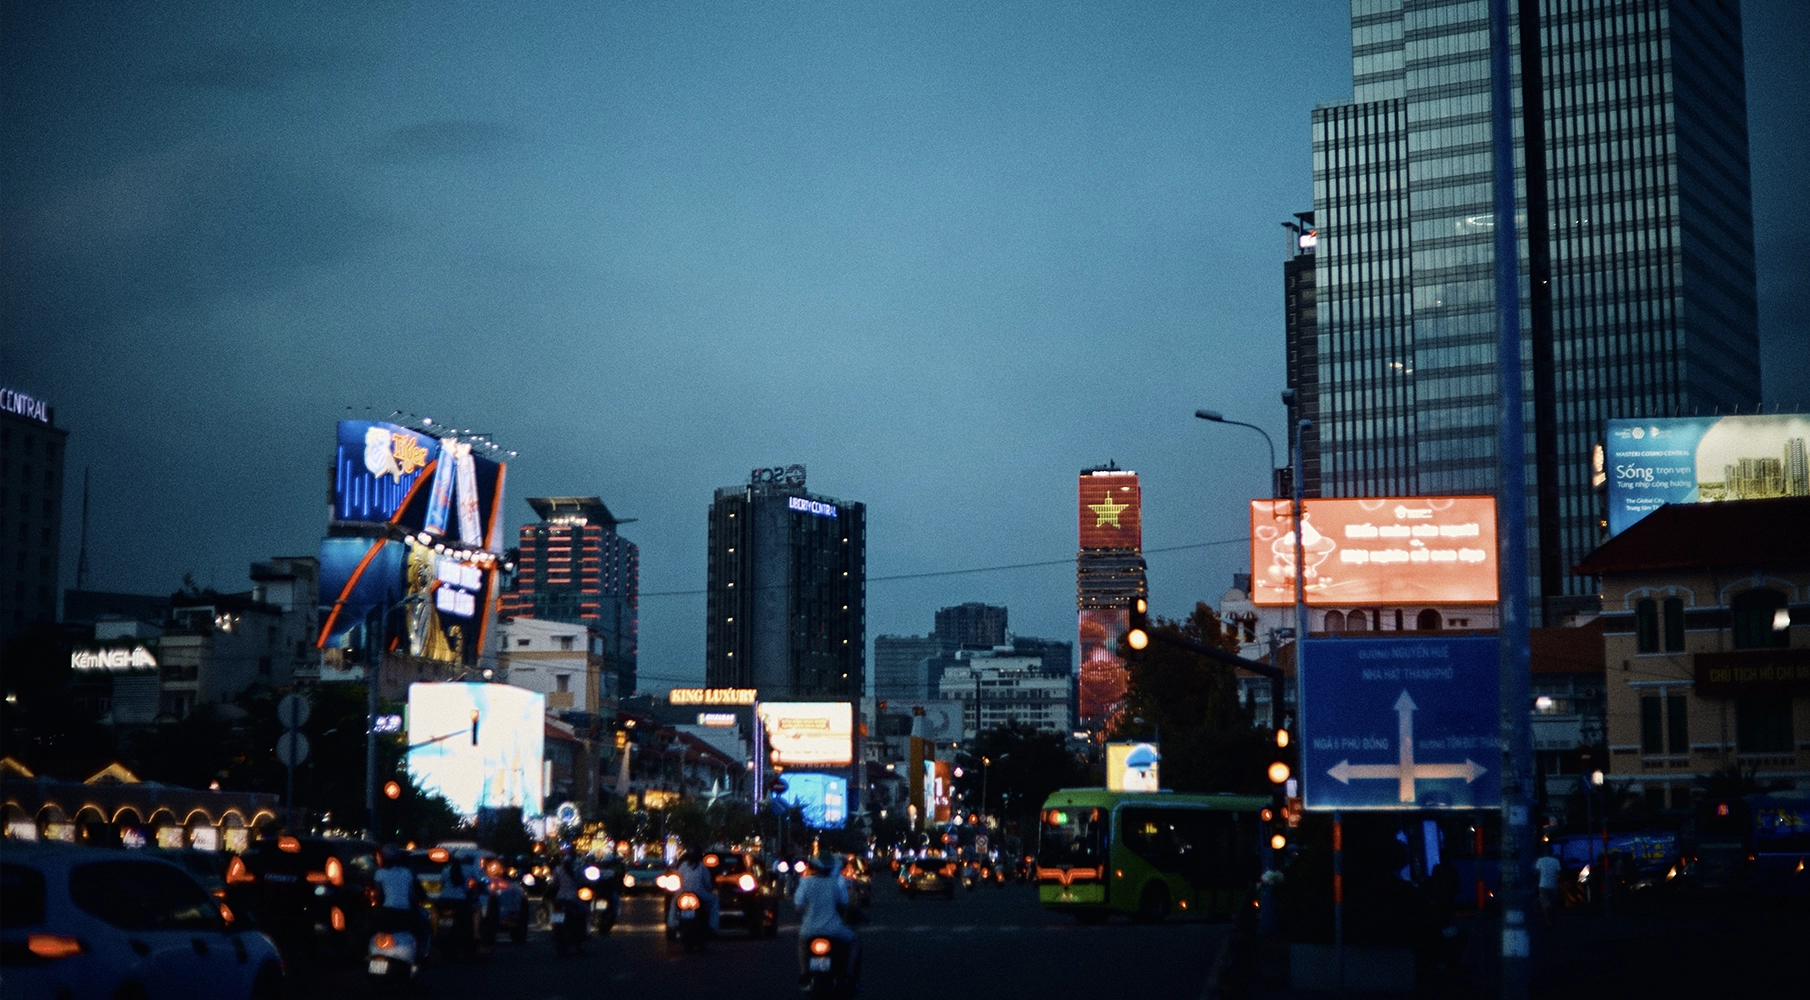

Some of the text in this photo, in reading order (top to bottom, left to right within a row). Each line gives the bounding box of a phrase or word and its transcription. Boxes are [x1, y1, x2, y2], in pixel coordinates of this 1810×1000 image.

[0, 388, 48, 422] CENTRAL
[392, 433, 429, 474] Tiger
[1616, 463, 1654, 482] Sống
[811, 500, 837, 518] CENTRAL
[670, 688, 757, 705] KING LUXURY
